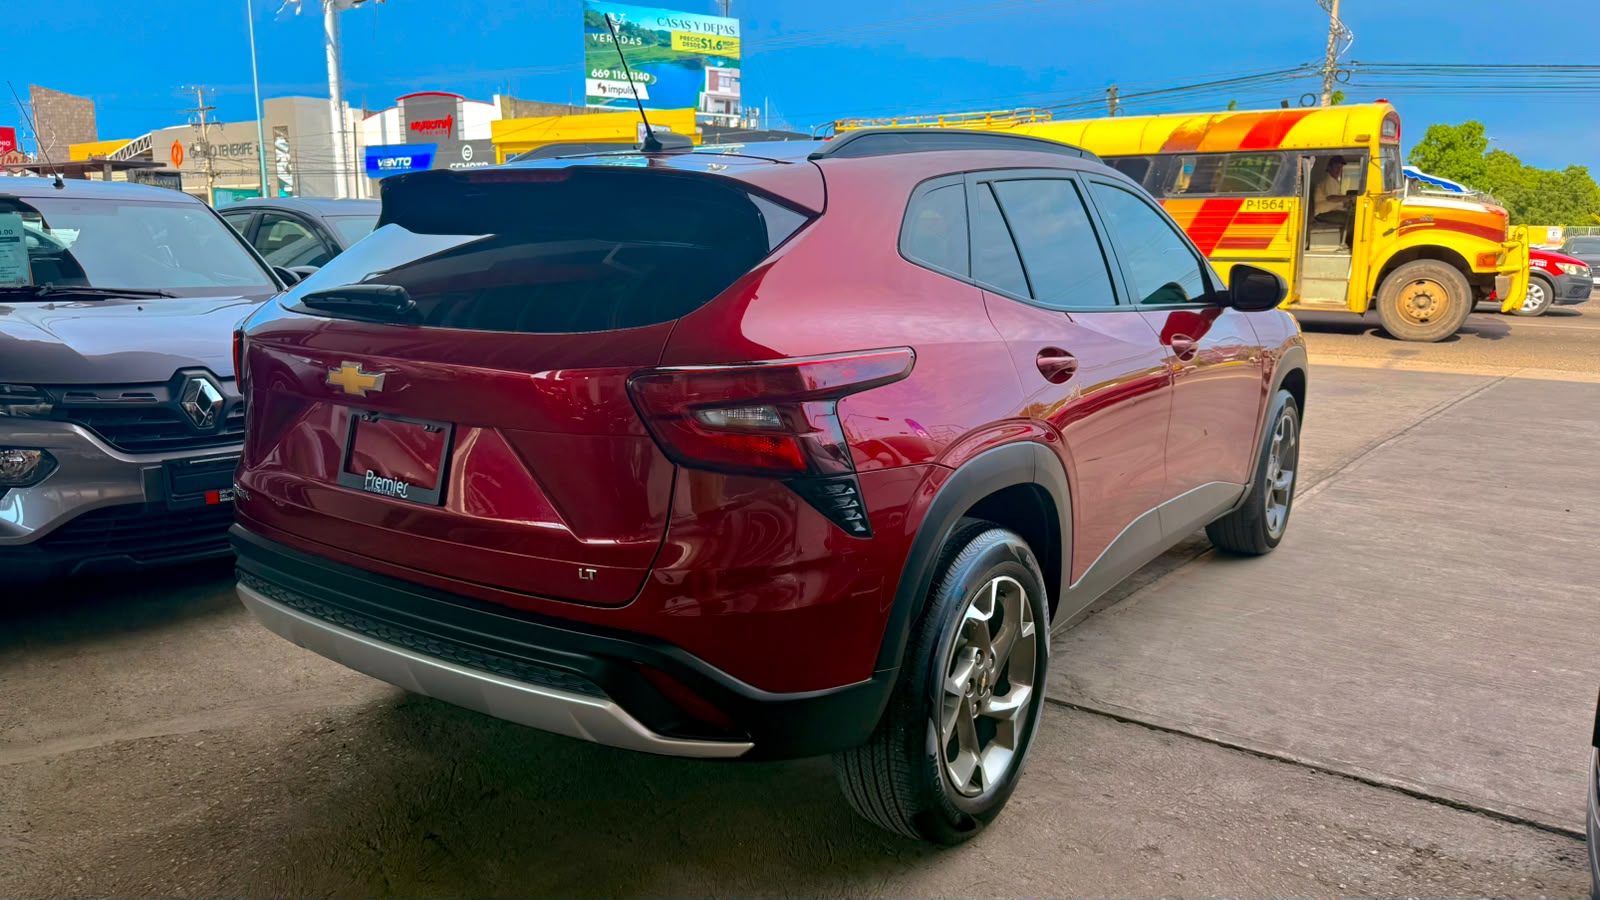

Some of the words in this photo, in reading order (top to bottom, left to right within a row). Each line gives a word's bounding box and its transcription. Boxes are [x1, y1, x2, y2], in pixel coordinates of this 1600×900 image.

[657, 17, 691, 31] CASAS
[694, 21, 701, 31] Y
[703, 22, 735, 35] DEPAS
[701, 38, 723, 50] $1.6
[591, 68, 610, 79] 669
[612, 70, 627, 80] 116
[630, 71, 650, 82] 1140
[377, 156, 412, 167] VENTO
[1246, 199, 1284, 210] P-1564
[365, 469, 409, 498] Premier
[578, 568, 597, 580] LT
